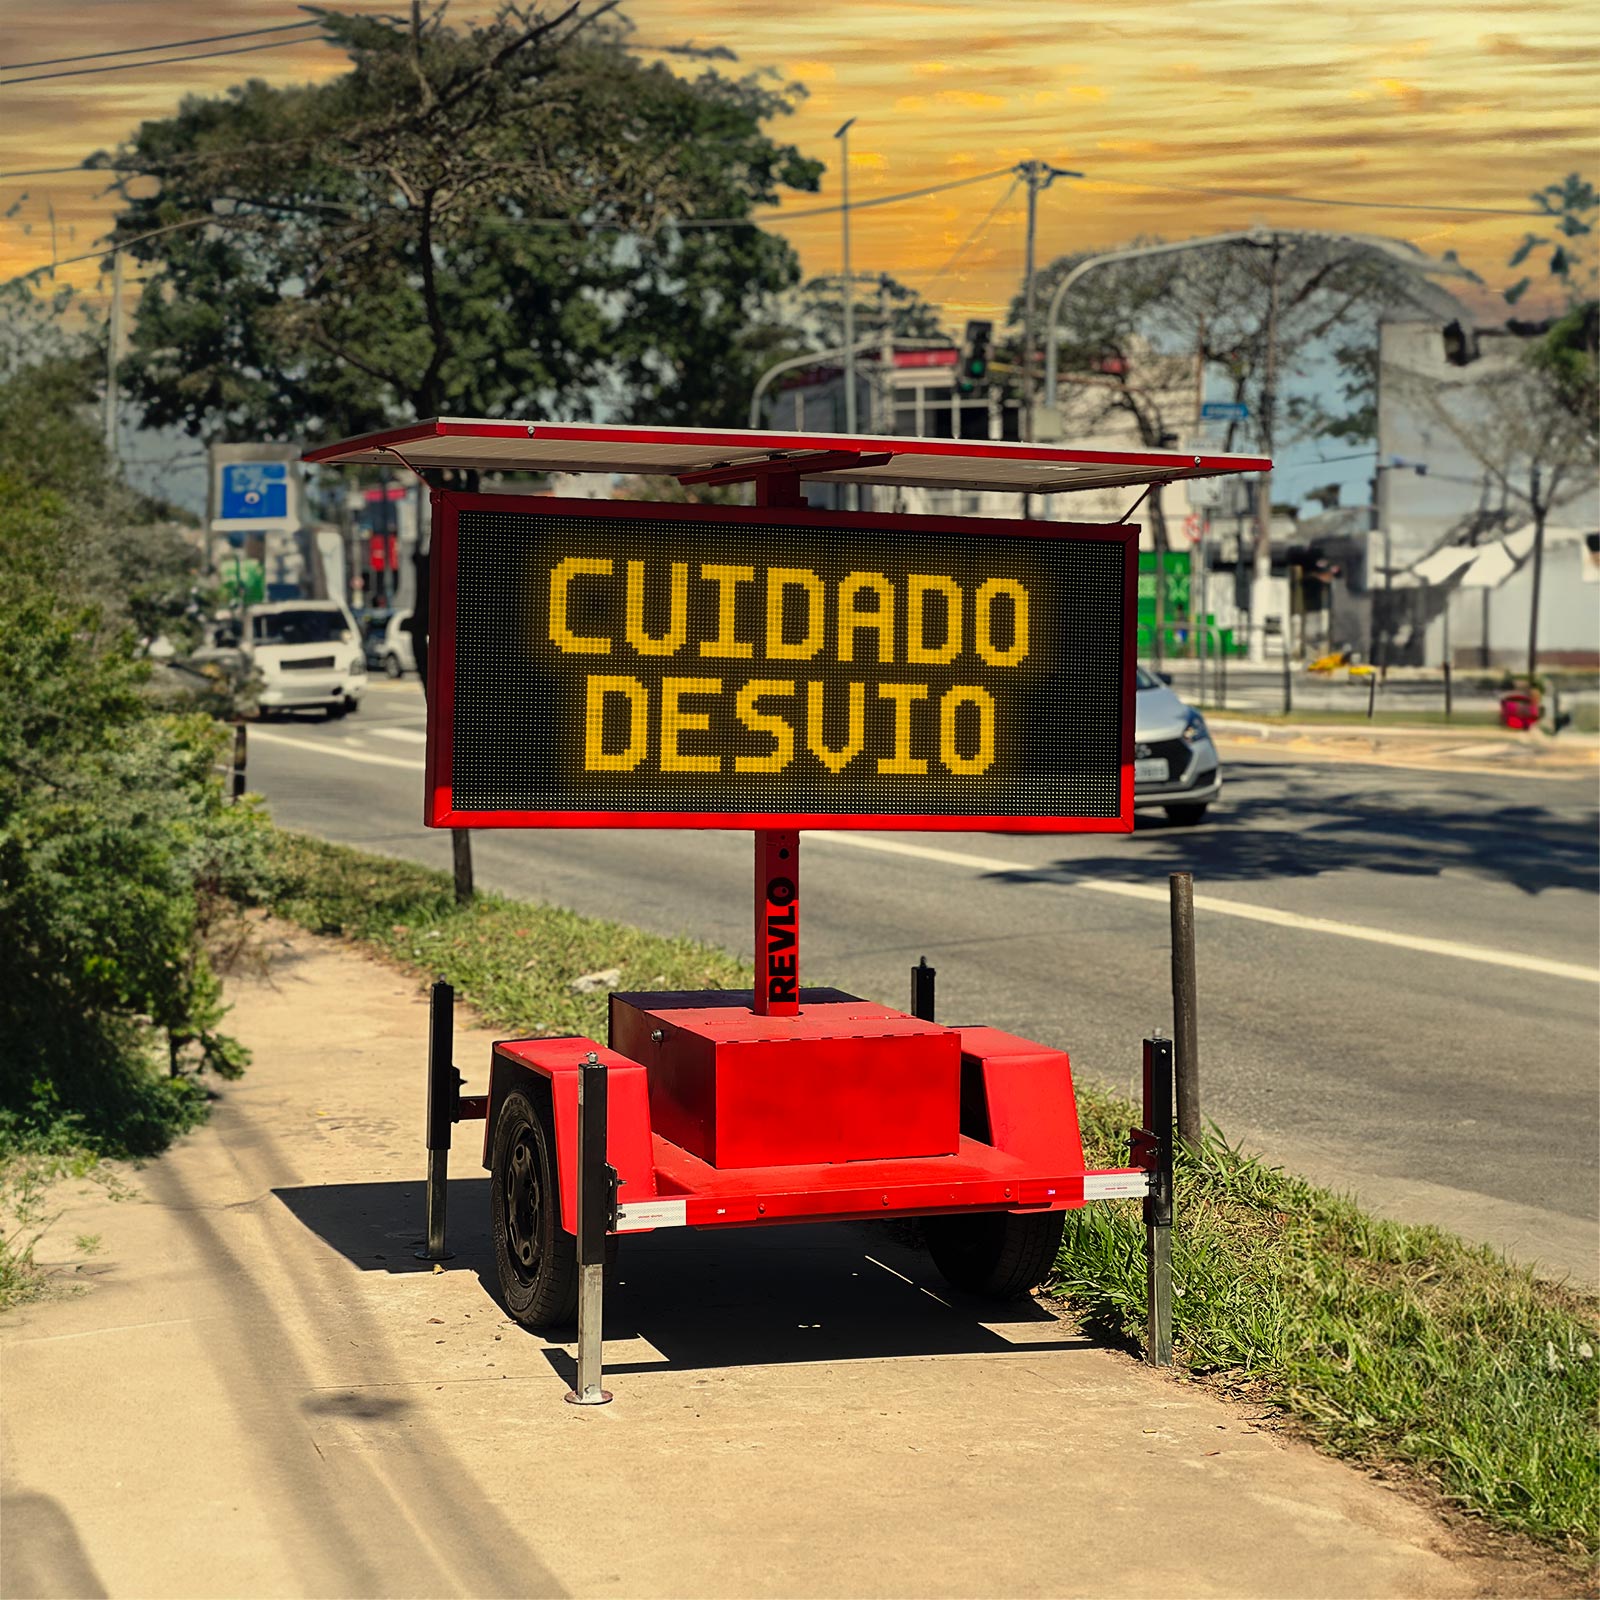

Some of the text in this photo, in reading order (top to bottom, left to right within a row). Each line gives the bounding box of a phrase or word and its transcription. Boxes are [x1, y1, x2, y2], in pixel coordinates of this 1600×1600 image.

[549, 557, 1029, 667] CUIDADO
[585, 675, 995, 775] DESVIO
[767, 877, 796, 1002] REVLO
